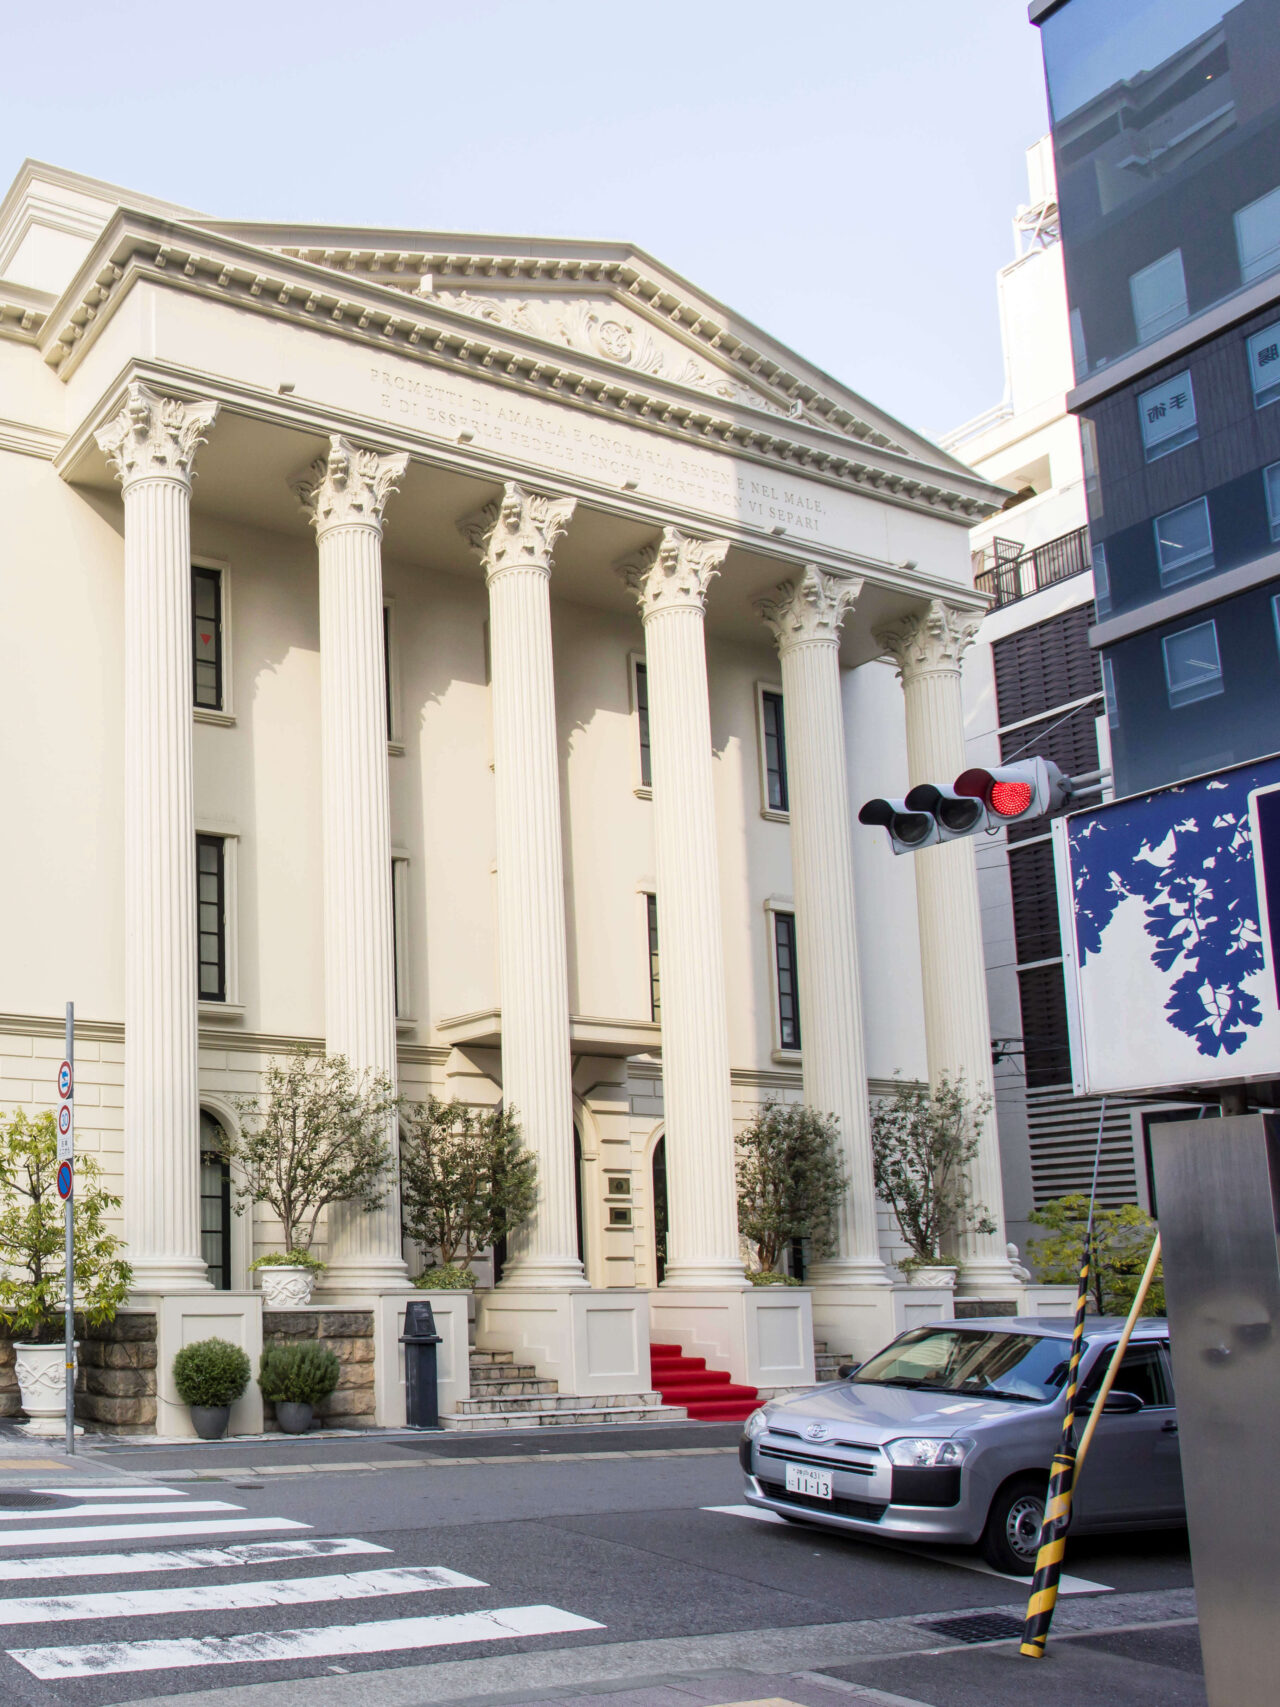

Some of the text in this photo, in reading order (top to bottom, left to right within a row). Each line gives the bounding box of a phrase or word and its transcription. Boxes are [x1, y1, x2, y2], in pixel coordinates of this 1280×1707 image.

[370, 368, 463, 407] PROMETTI
[472, 399, 489, 416] DI
[497, 407, 567, 438] AMARLA
[574, 429, 583, 442] E
[589, 433, 674, 468] ONORARLA
[737, 477, 745, 490] E
[751, 480, 779, 501] NEL
[783, 491, 827, 515] MALE,
[381, 393, 391, 408] E
[400, 399, 417, 417] DI
[426, 408, 504, 441] ESSERLE
[511, 432, 575, 462] FEDELE
[652, 472, 706, 499] MORTE
[712, 489, 743, 509] NON
[747, 501, 764, 516] VI
[769, 506, 821, 531] SEPARI
[61, 1112, 69, 1128] 30
